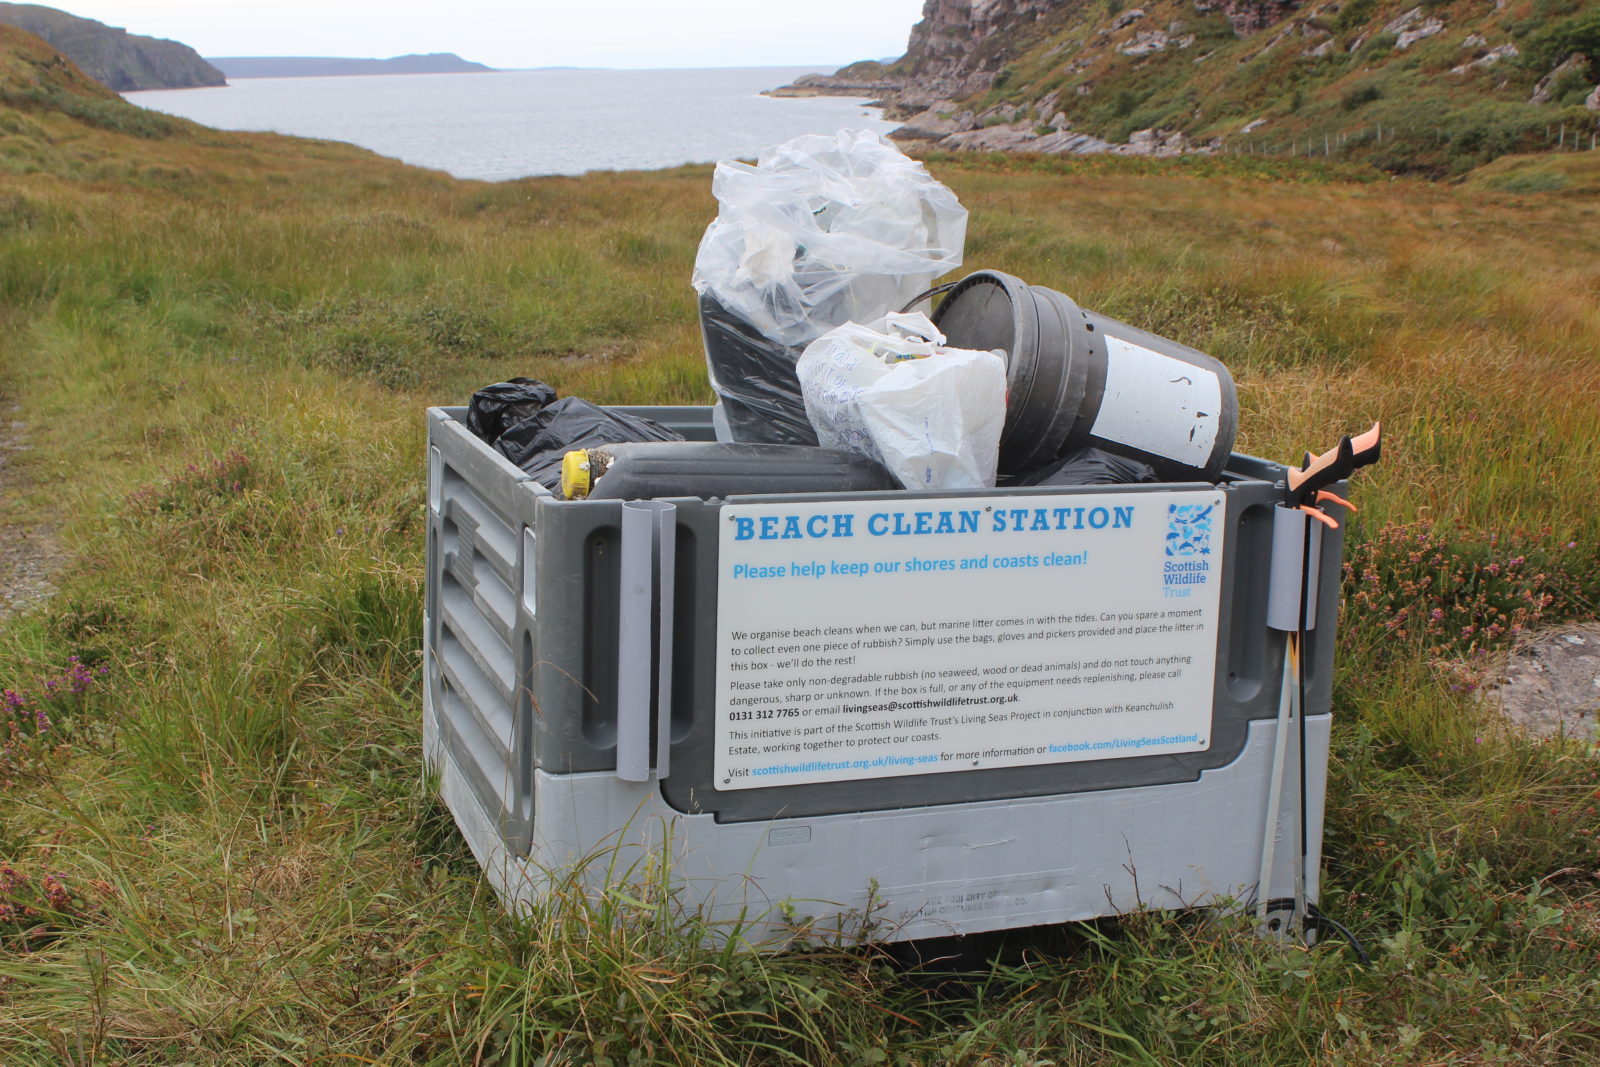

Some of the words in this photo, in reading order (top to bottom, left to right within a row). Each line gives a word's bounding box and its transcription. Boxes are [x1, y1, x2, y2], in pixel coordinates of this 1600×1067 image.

[734, 514, 854, 540] BEACH
[867, 511, 982, 536] CLEAN
[992, 506, 1134, 532] STATION
[733, 564, 787, 578] Please
[791, 561, 827, 578] help
[830, 560, 870, 576] keep
[873, 562, 902, 573] our
[904, 558, 956, 572] shores
[959, 555, 989, 569] and
[992, 555, 1040, 568] coasts
[1043, 551, 1088, 566] clean!
[1164, 560, 1208, 572] Scottish
[1164, 573, 1206, 585] Wildlife
[1163, 586, 1192, 598] Trust
[731, 632, 748, 640] We
[750, 631, 791, 641] organise
[793, 627, 822, 638] beach
[823, 627, 853, 636] cleans
[855, 625, 881, 634] when
[899, 624, 918, 632] can,
[921, 622, 936, 631] but
[972, 620, 994, 628] litter
[995, 619, 1024, 627] comes
[1036, 616, 1056, 625] with
[1058, 615, 1073, 624] the
[1075, 614, 1097, 623] tides.
[1100, 613, 1116, 622] Can
[1118, 614, 1133, 622] you
[1135, 612, 1159, 621] spare
[1167, 609, 1202, 618] moment
[731, 648, 741, 656] to
[743, 646, 775, 655] collect
[777, 646, 800, 654] even
[802, 644, 821, 652] one
[823, 642, 849, 653] piece
[850, 640, 862, 650] of
[862, 638, 903, 649] rubbish?
[905, 637, 935, 647] Simply
[937, 637, 953, 645] use
[955, 635, 970, 644] the
[972, 634, 995, 644] bags,
[997, 632, 1025, 643] gloves
[1027, 630, 1044, 640] and
[1045, 630, 1076, 640] pickers
[1077, 627, 1115, 638] provided
[1117, 626, 1133, 635] and
[1135, 625, 1157, 635] place
[1159, 624, 1173, 633] the
[1175, 624, 1195, 632] litter
[730, 662, 749, 671] this
[751, 662, 768, 670] box
[801, 658, 814, 668] do
[816, 657, 832, 667] the
[834, 656, 856, 665] rest!
[730, 681, 761, 690] Please
[763, 680, 784, 689] take
[786, 678, 807, 688] only
[809, 674, 882, 686] non-degradable
[884, 671, 919, 681] rubbish
[921, 670, 936, 681] (no
[938, 667, 980, 678] seaweed,
[982, 666, 1007, 675] wood
[1021, 664, 1043, 673] dead
[1044, 661, 1081, 672] animals)
[1082, 660, 1099, 669] and
[1100, 659, 1112, 668] do
[1114, 659, 1128, 667] not
[1130, 657, 1154, 666] touch
[1156, 656, 1192, 666] anything
[730, 697, 782, 707] dangerous,
[785, 694, 812, 703] sharp
[826, 691, 872, 700] unknown.
[875, 688, 882, 696] If
[883, 687, 899, 696] the
[901, 686, 918, 695] box
[920, 686, 927, 694] is
[929, 684, 946, 693] full,
[960, 684, 977, 692] any
[978, 681, 988, 690] of
[990, 680, 1005, 689] the
[1006, 678, 1054, 689] equipment
[1056, 676, 1082, 685] needs
[1084, 673, 1137, 684] replenishing,
[1139, 671, 1166, 681] please
[1168, 669, 1182, 678] call
[729, 712, 753, 721] 0131
[756, 710, 774, 720] 312
[776, 708, 800, 718] 7765
[802, 709, 813, 717] or
[814, 705, 840, 716] email
[729, 731, 748, 740] This
[750, 730, 792, 738] initiative
[803, 726, 823, 737] part
[825, 724, 836, 734] of
[837, 724, 853, 733] the
[855, 721, 891, 732] Scottish
[893, 718, 928, 728] Wildlife
[961, 716, 986, 725] Living
[988, 714, 1008, 722] Seas
[1010, 712, 1041, 721] Project
[1052, 708, 1102, 718] conjunction
[1104, 705, 1124, 714] with
[1125, 702, 1174, 712] Keanchulish
[728, 746, 760, 756] Estate,
[763, 743, 801, 753] working
[803, 740, 844, 751] together
[845, 739, 856, 747] to
[857, 737, 891, 747] protect
[893, 736, 909, 744] our
[911, 733, 941, 742] coasts.
[728, 767, 749, 777] Visit
[751, 755, 938, 776] scottishwildlifetrust.org.uk/living-seas
[940, 752, 954, 761] for
[955, 752, 980, 760] more
[982, 748, 1035, 757] information
[1048, 734, 1198, 752] facebook.com/LivingSeasScotland
